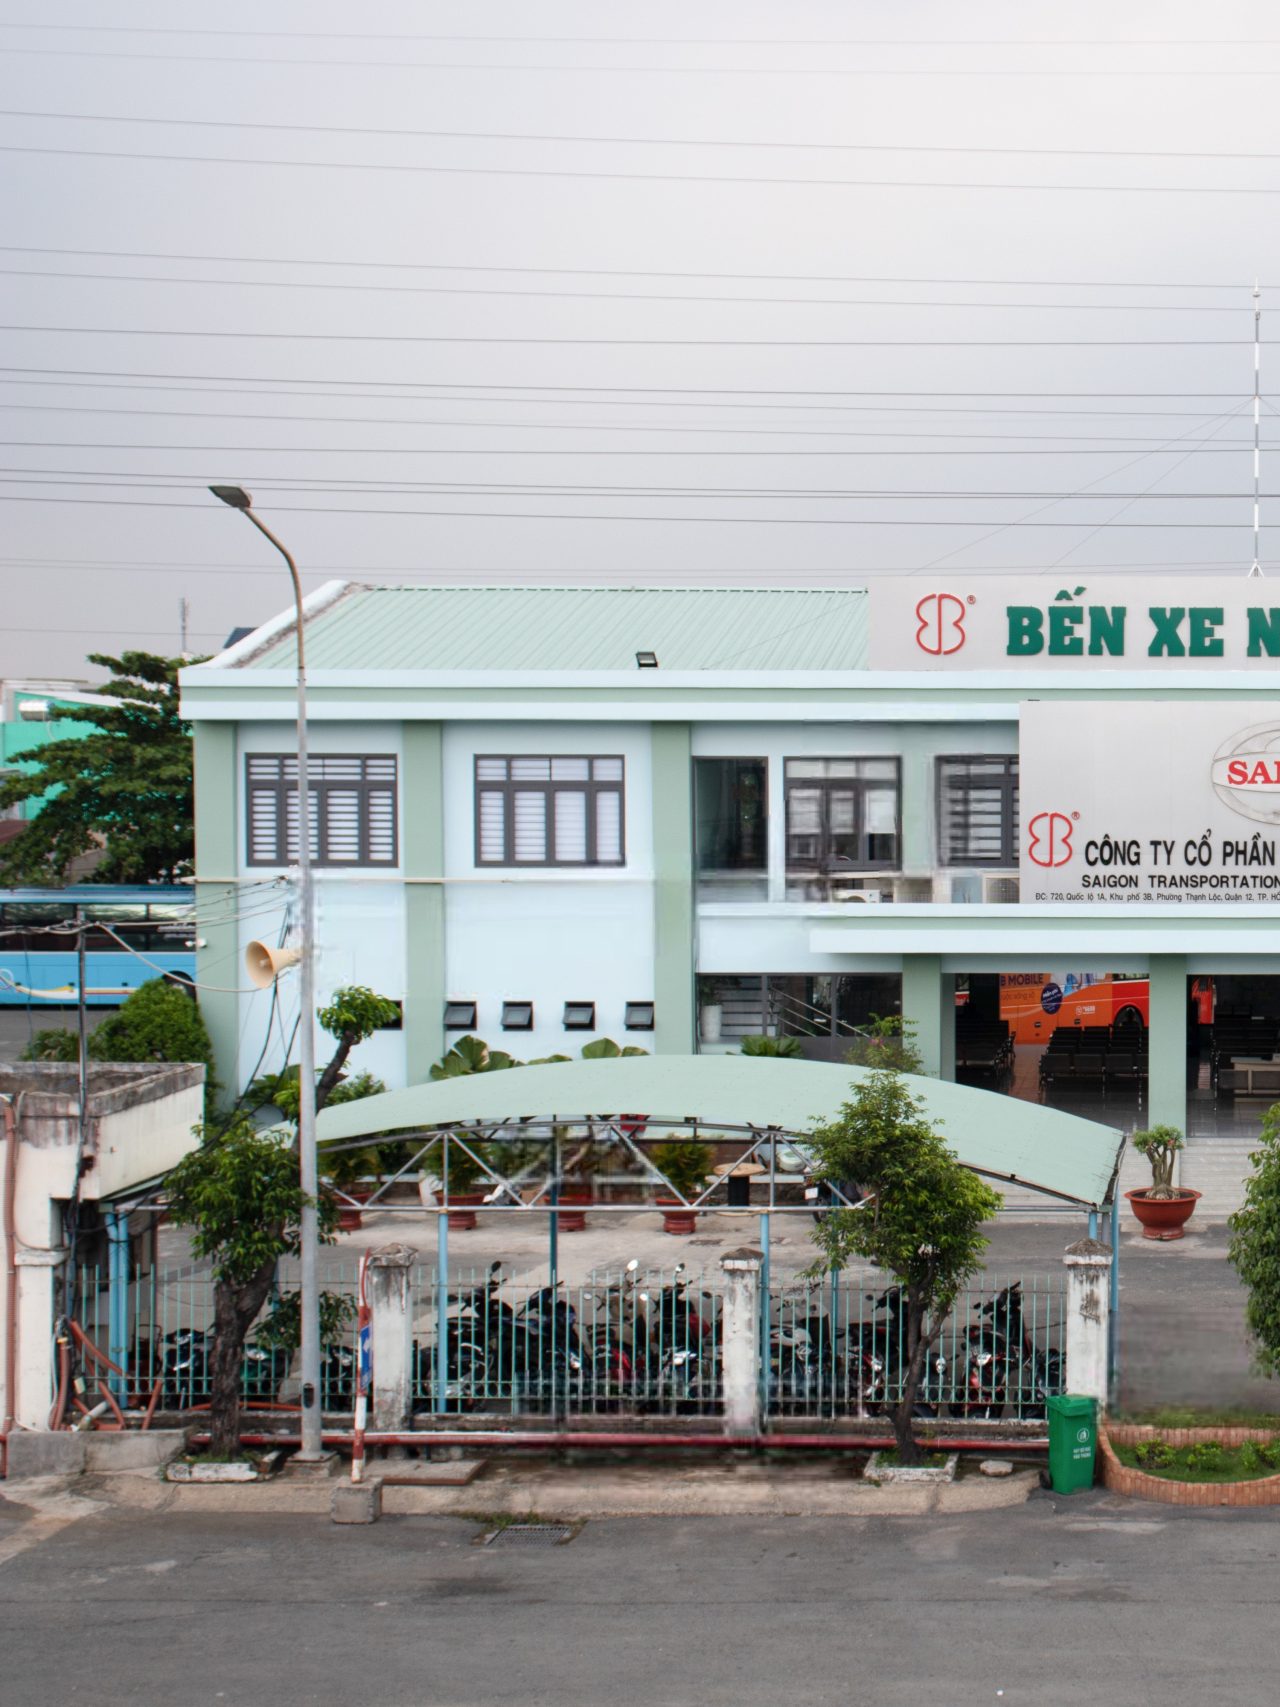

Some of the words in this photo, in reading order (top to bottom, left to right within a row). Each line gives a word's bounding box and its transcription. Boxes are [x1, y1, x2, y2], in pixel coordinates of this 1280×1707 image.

[1006, 586, 1127, 657] BẾN
[1148, 607, 1224, 657] XE
[1084, 834, 1141, 867] CÔNG
[1149, 840, 1176, 866] TY
[1183, 828, 1212, 867] CỔ
[1222, 832, 1276, 866] PHẦN
[1081, 874, 1139, 889] SAIGON
[1109, 892, 1124, 901] Khu
[1008, 973, 1043, 986] MOBILE
